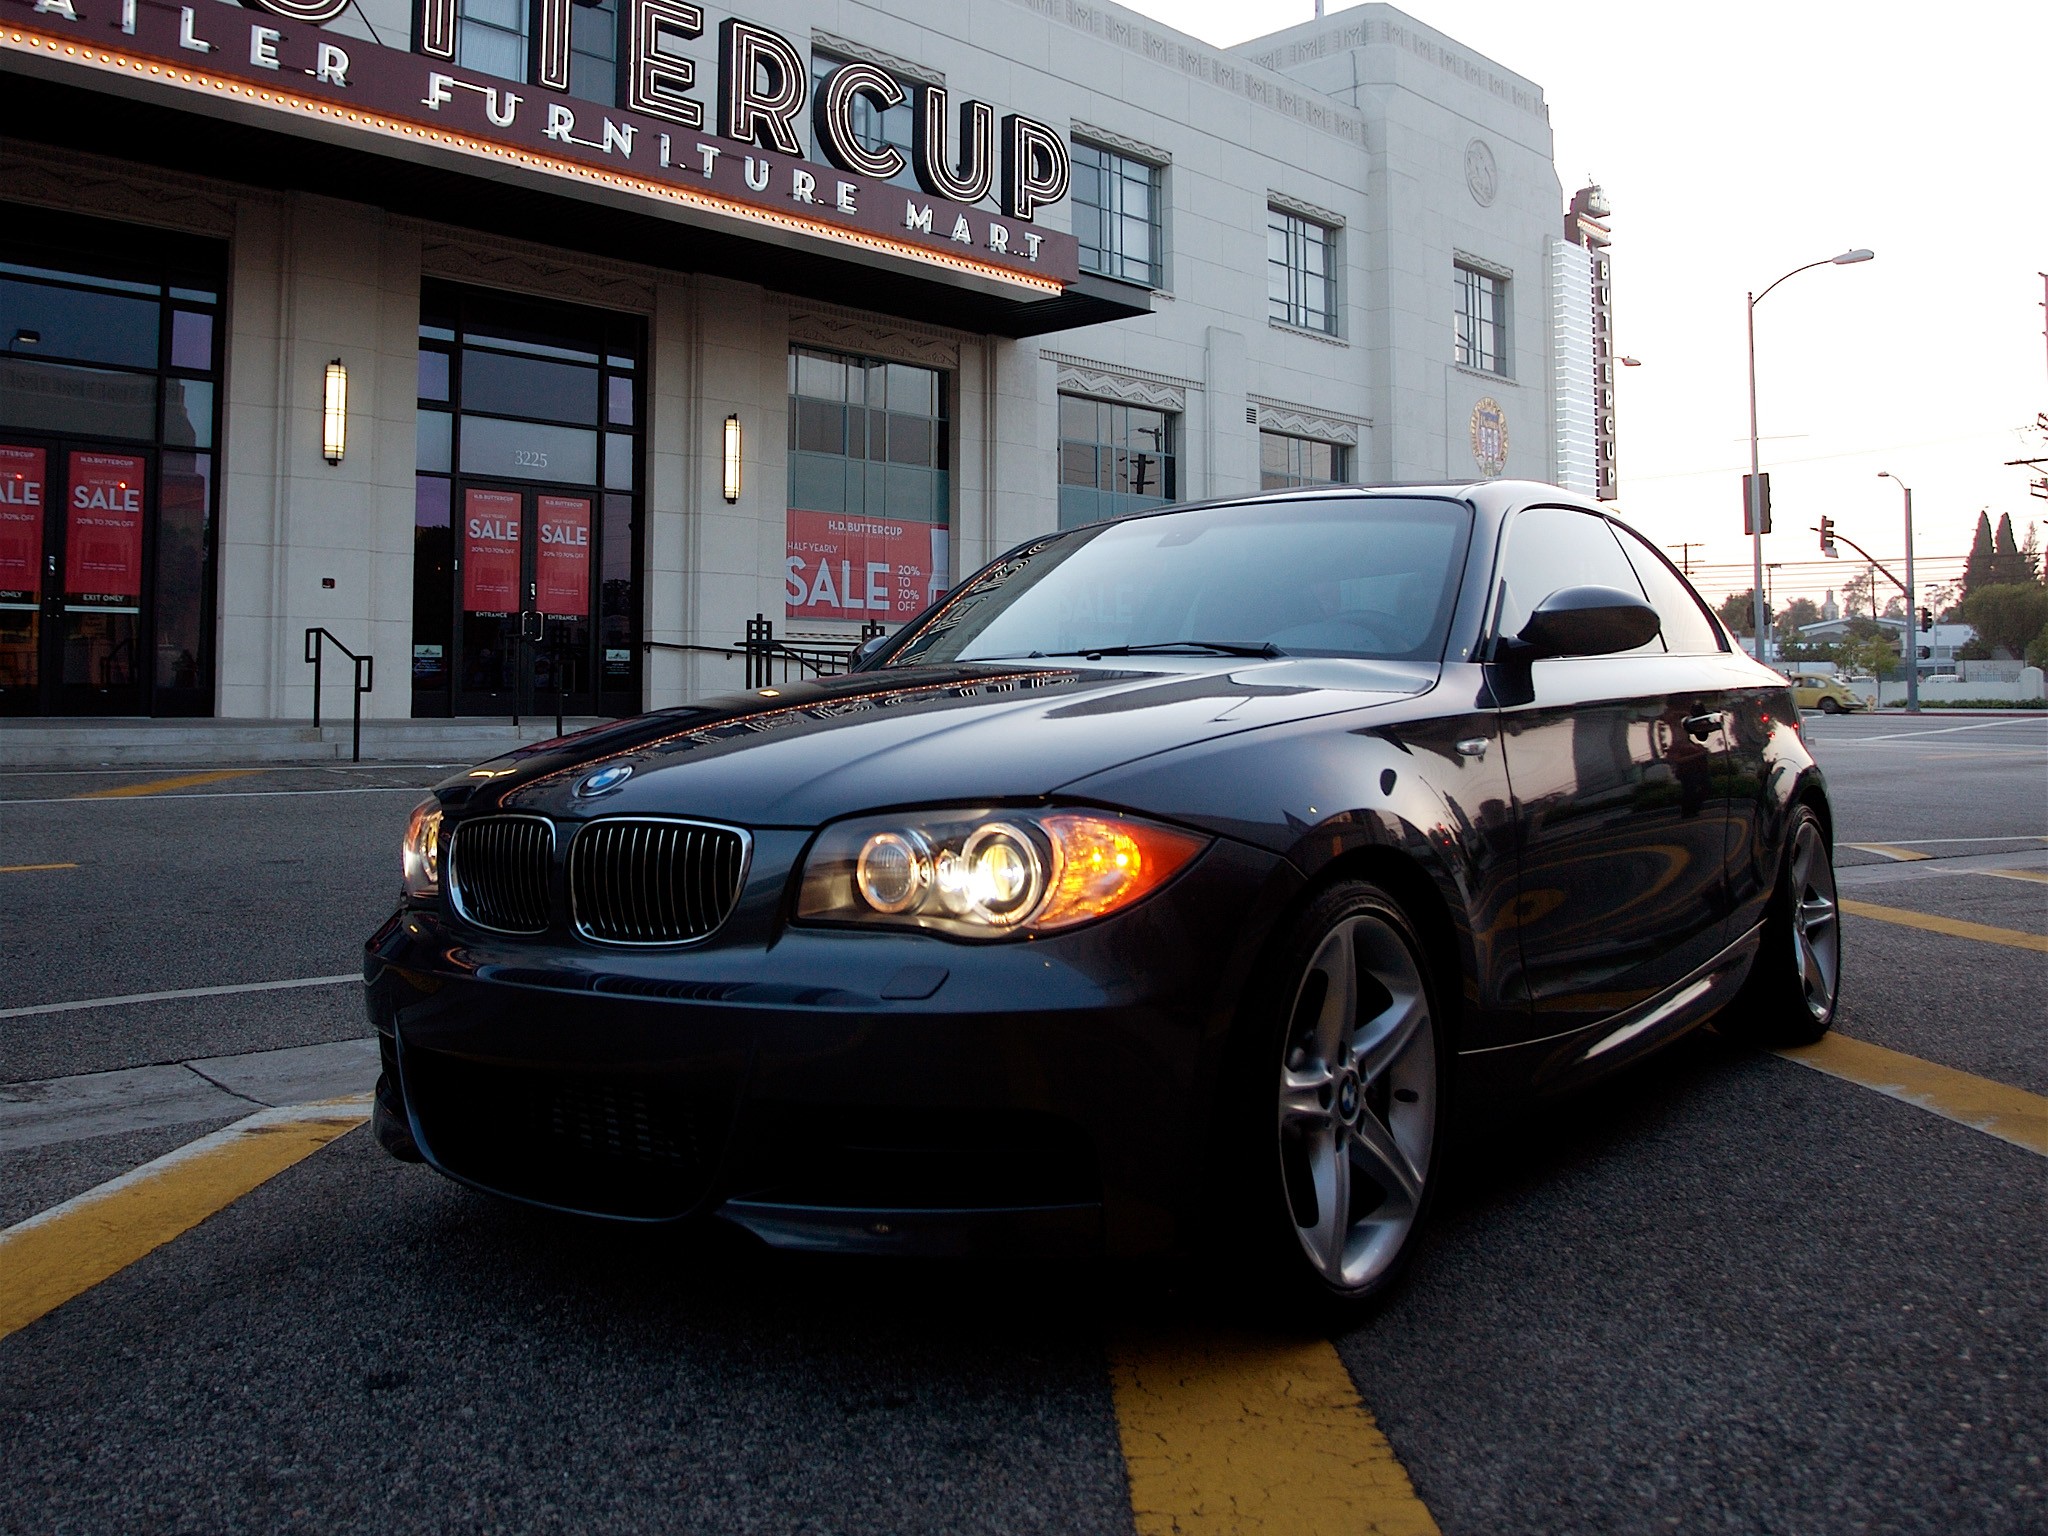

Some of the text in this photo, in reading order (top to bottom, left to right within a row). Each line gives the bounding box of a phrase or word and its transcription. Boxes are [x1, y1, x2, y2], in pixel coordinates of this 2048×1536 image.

[428, 72, 858, 215] FURNITURE
[905, 199, 1047, 260] MART
[1598, 260, 1615, 486] BUTTERCUP
[95, 457, 134, 466] BUTTERCUP
[514, 450, 548, 468] 3225
[73, 485, 140, 512] SALE
[469, 518, 519, 541] SALE
[541, 523, 588, 546] SALE
[828, 520, 846, 531] H.D.
[847, 521, 903, 537] BUTTERCUP
[787, 541, 839, 554] HALF YEARLY
[898, 565, 921, 576] 20%
[786, 555, 890, 611] SALE
[898, 576, 911, 588] TO
[898, 588, 920, 600] 70%
[897, 600, 916, 612] OFF
[476, 611, 508, 619] ENTRANCE
[548, 614, 578, 622] ENTRANCE
